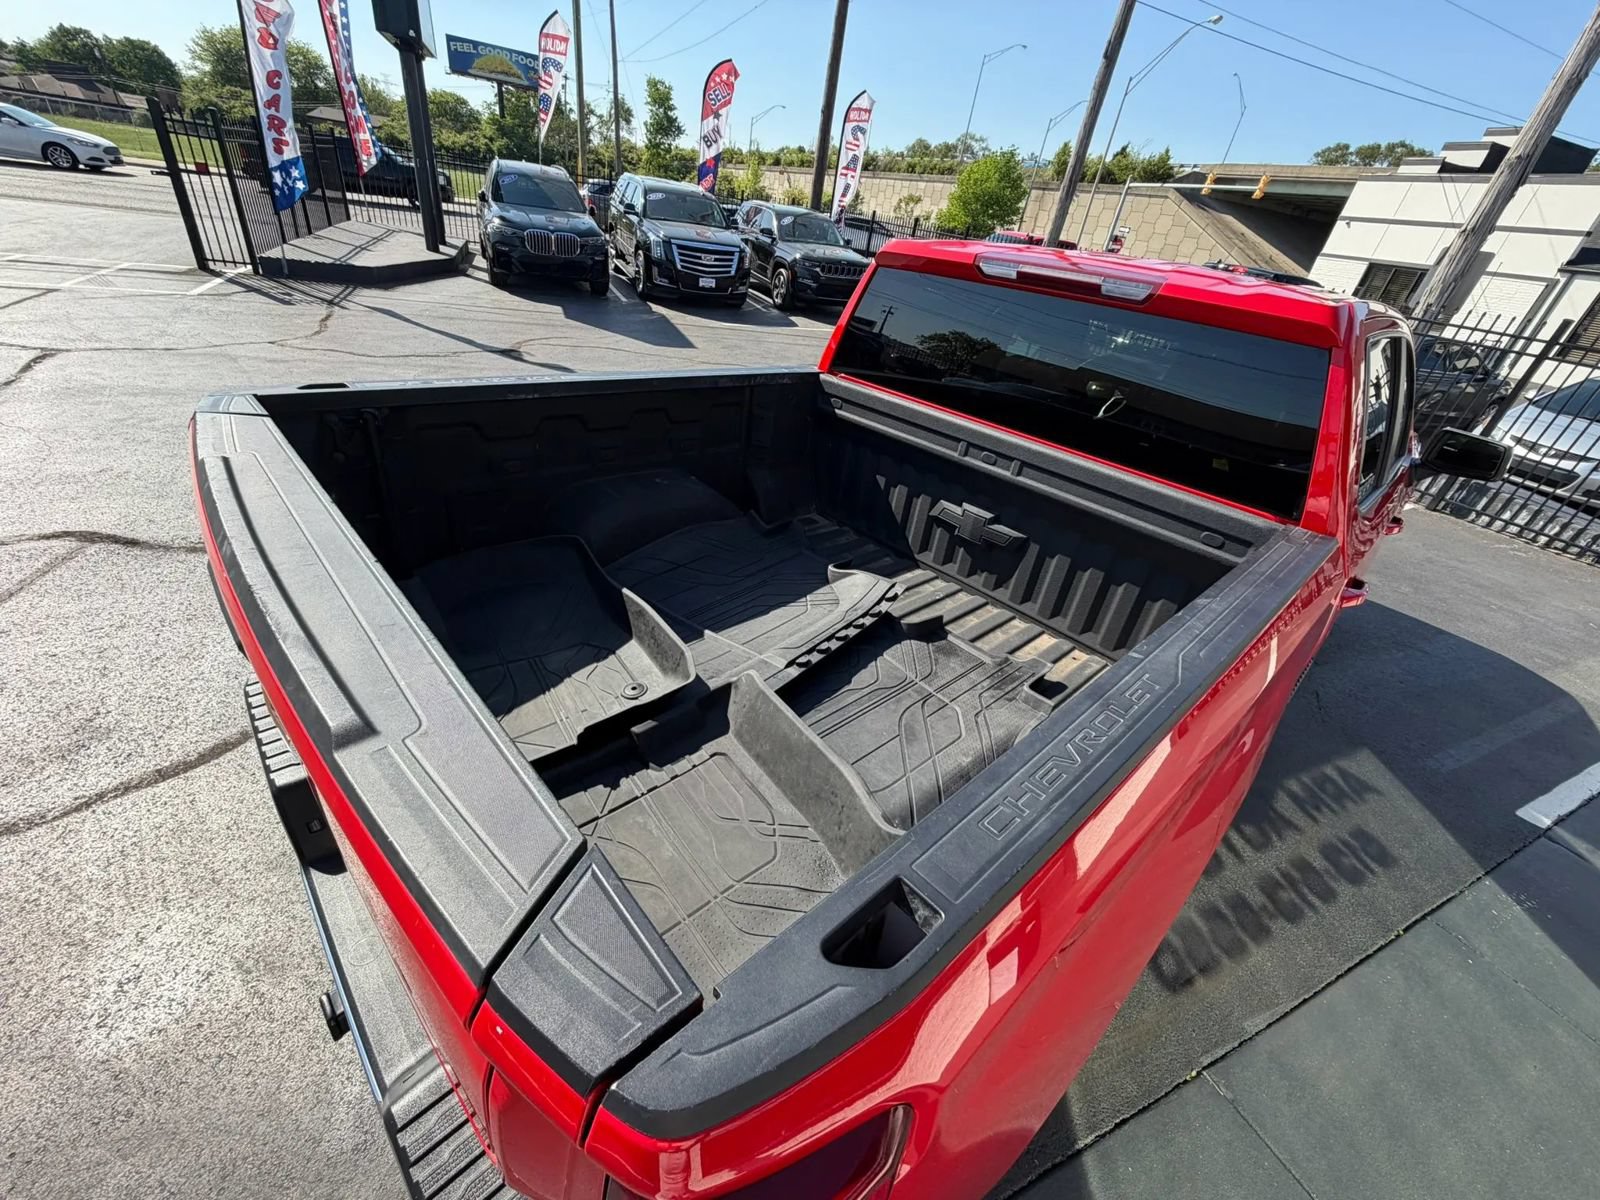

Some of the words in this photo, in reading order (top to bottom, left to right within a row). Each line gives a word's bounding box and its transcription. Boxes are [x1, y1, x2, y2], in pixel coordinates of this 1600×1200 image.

[449, 41, 477, 54] FEEL
[478, 45, 510, 60] GOOD
[707, 82, 730, 107] SELL
[263, 69, 290, 155] CARS
[702, 125, 722, 149] BUY
[978, 673, 1160, 840] CHEVROLET
